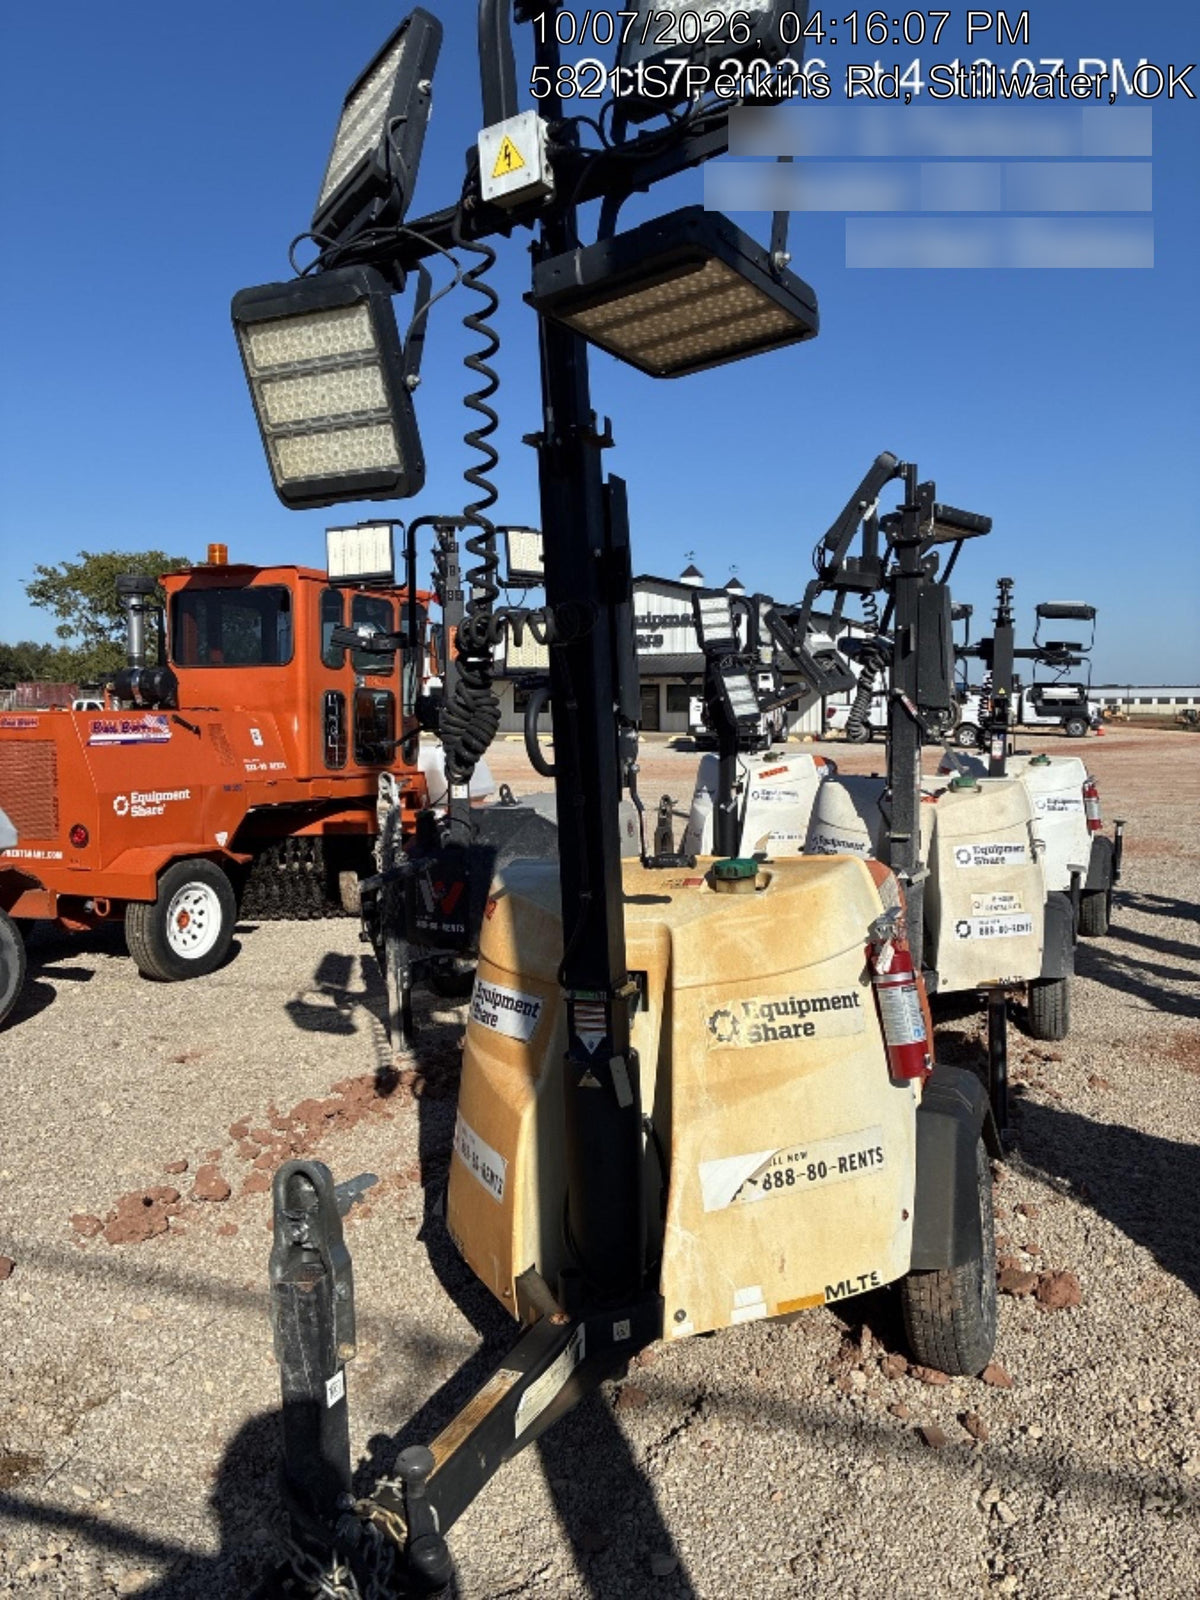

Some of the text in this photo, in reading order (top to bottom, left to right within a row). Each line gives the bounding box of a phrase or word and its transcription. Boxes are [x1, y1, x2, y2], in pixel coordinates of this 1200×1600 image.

[130, 788, 191, 806] Equipment
[130, 803, 166, 817] Share
[741, 991, 861, 1022] Equipment
[747, 1021, 816, 1043] Share
[762, 1146, 884, 1191] 888-80-RENTS
